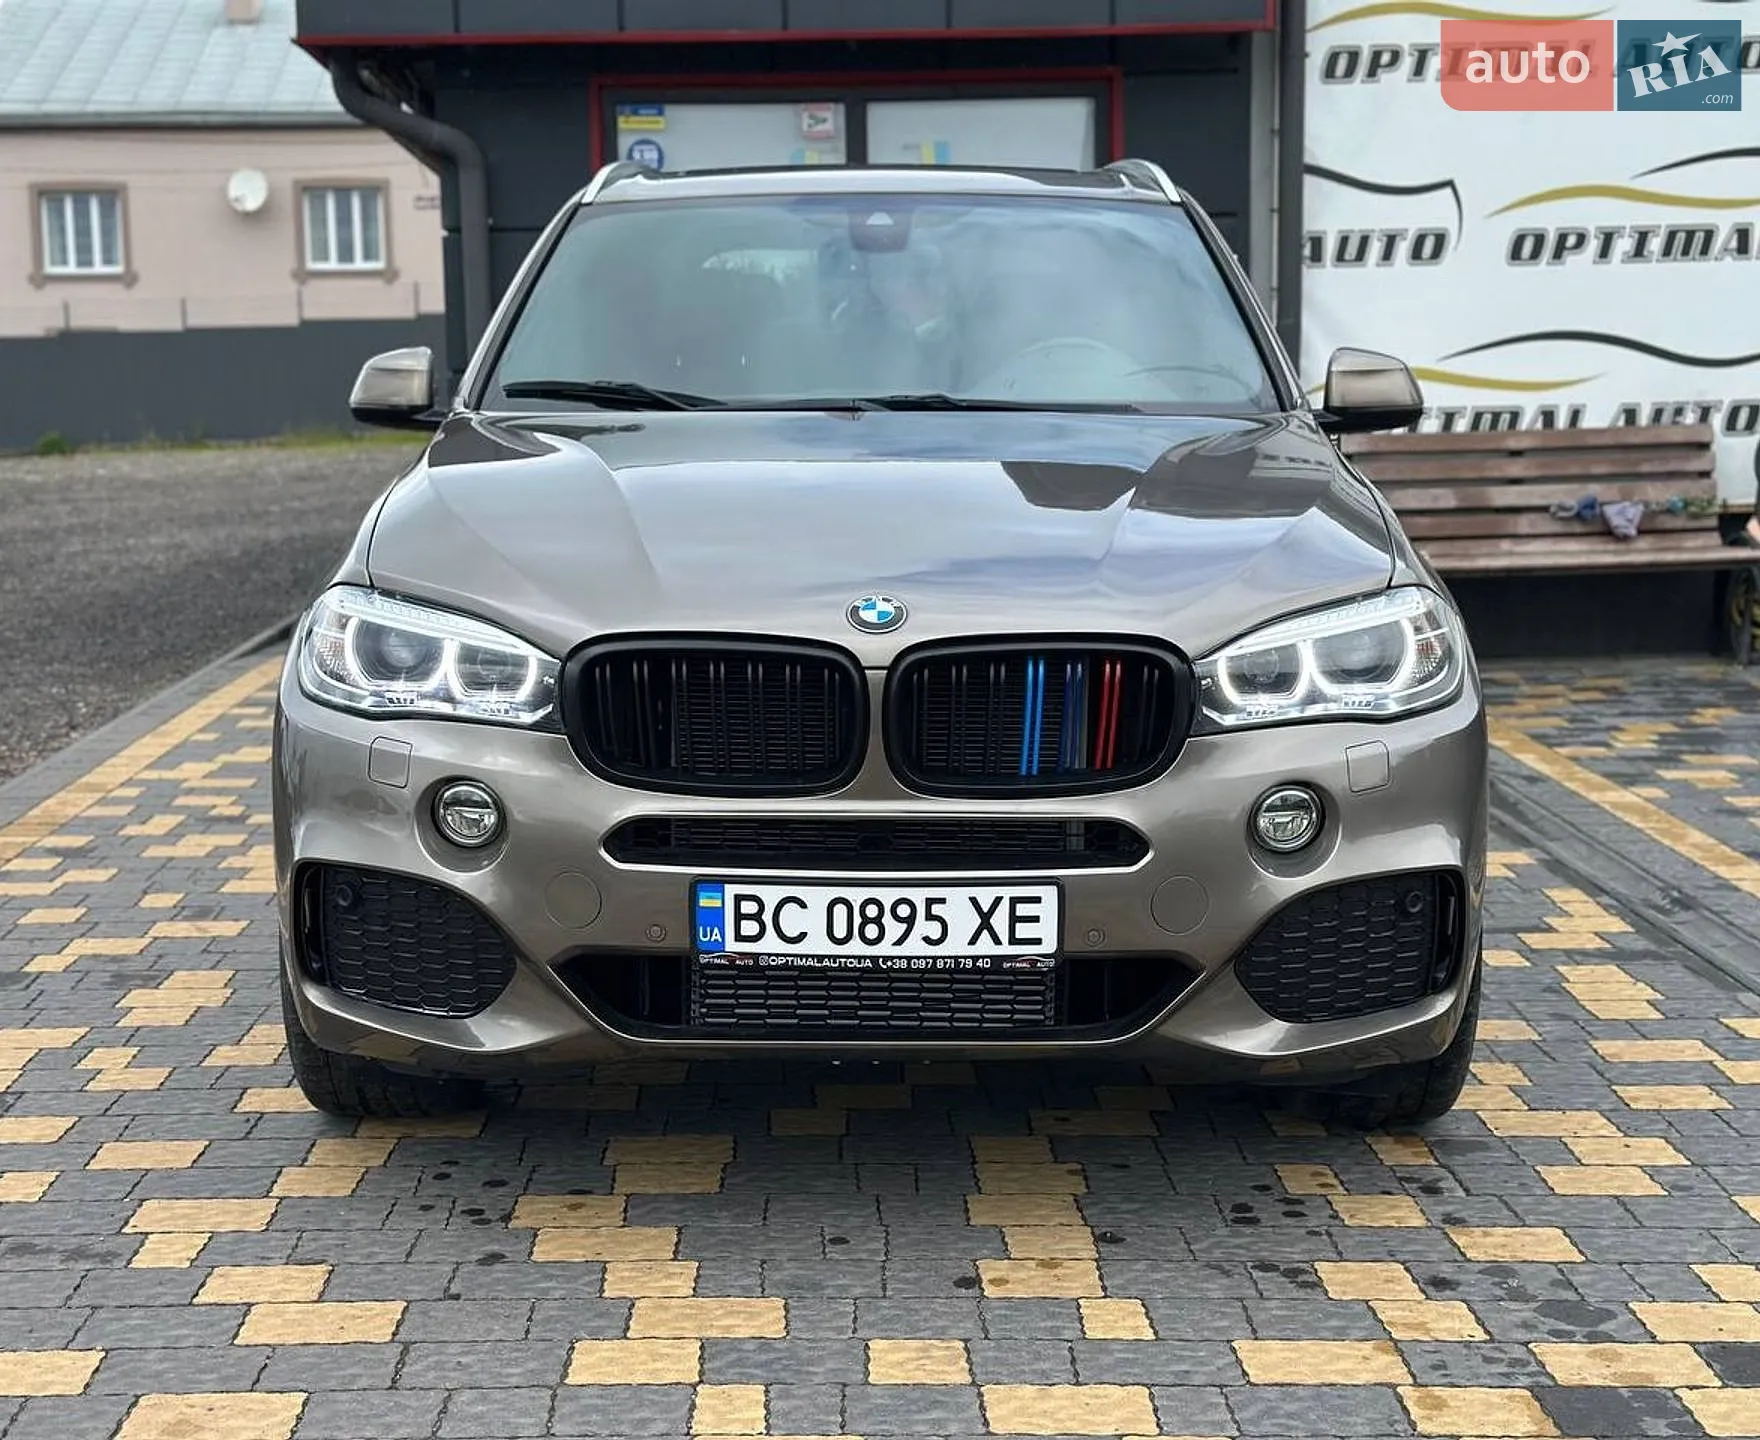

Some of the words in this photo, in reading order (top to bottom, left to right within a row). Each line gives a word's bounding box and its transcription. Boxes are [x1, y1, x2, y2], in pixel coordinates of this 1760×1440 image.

[1506, 222, 1760, 267] OPTIMA
[699, 927, 722, 941] UA
[733, 893, 808, 946] BC
[826, 896, 949, 947] 0895
[967, 895, 1043, 946] XE
[911, 958, 932, 969] 097
[976, 957, 991, 968] 40
